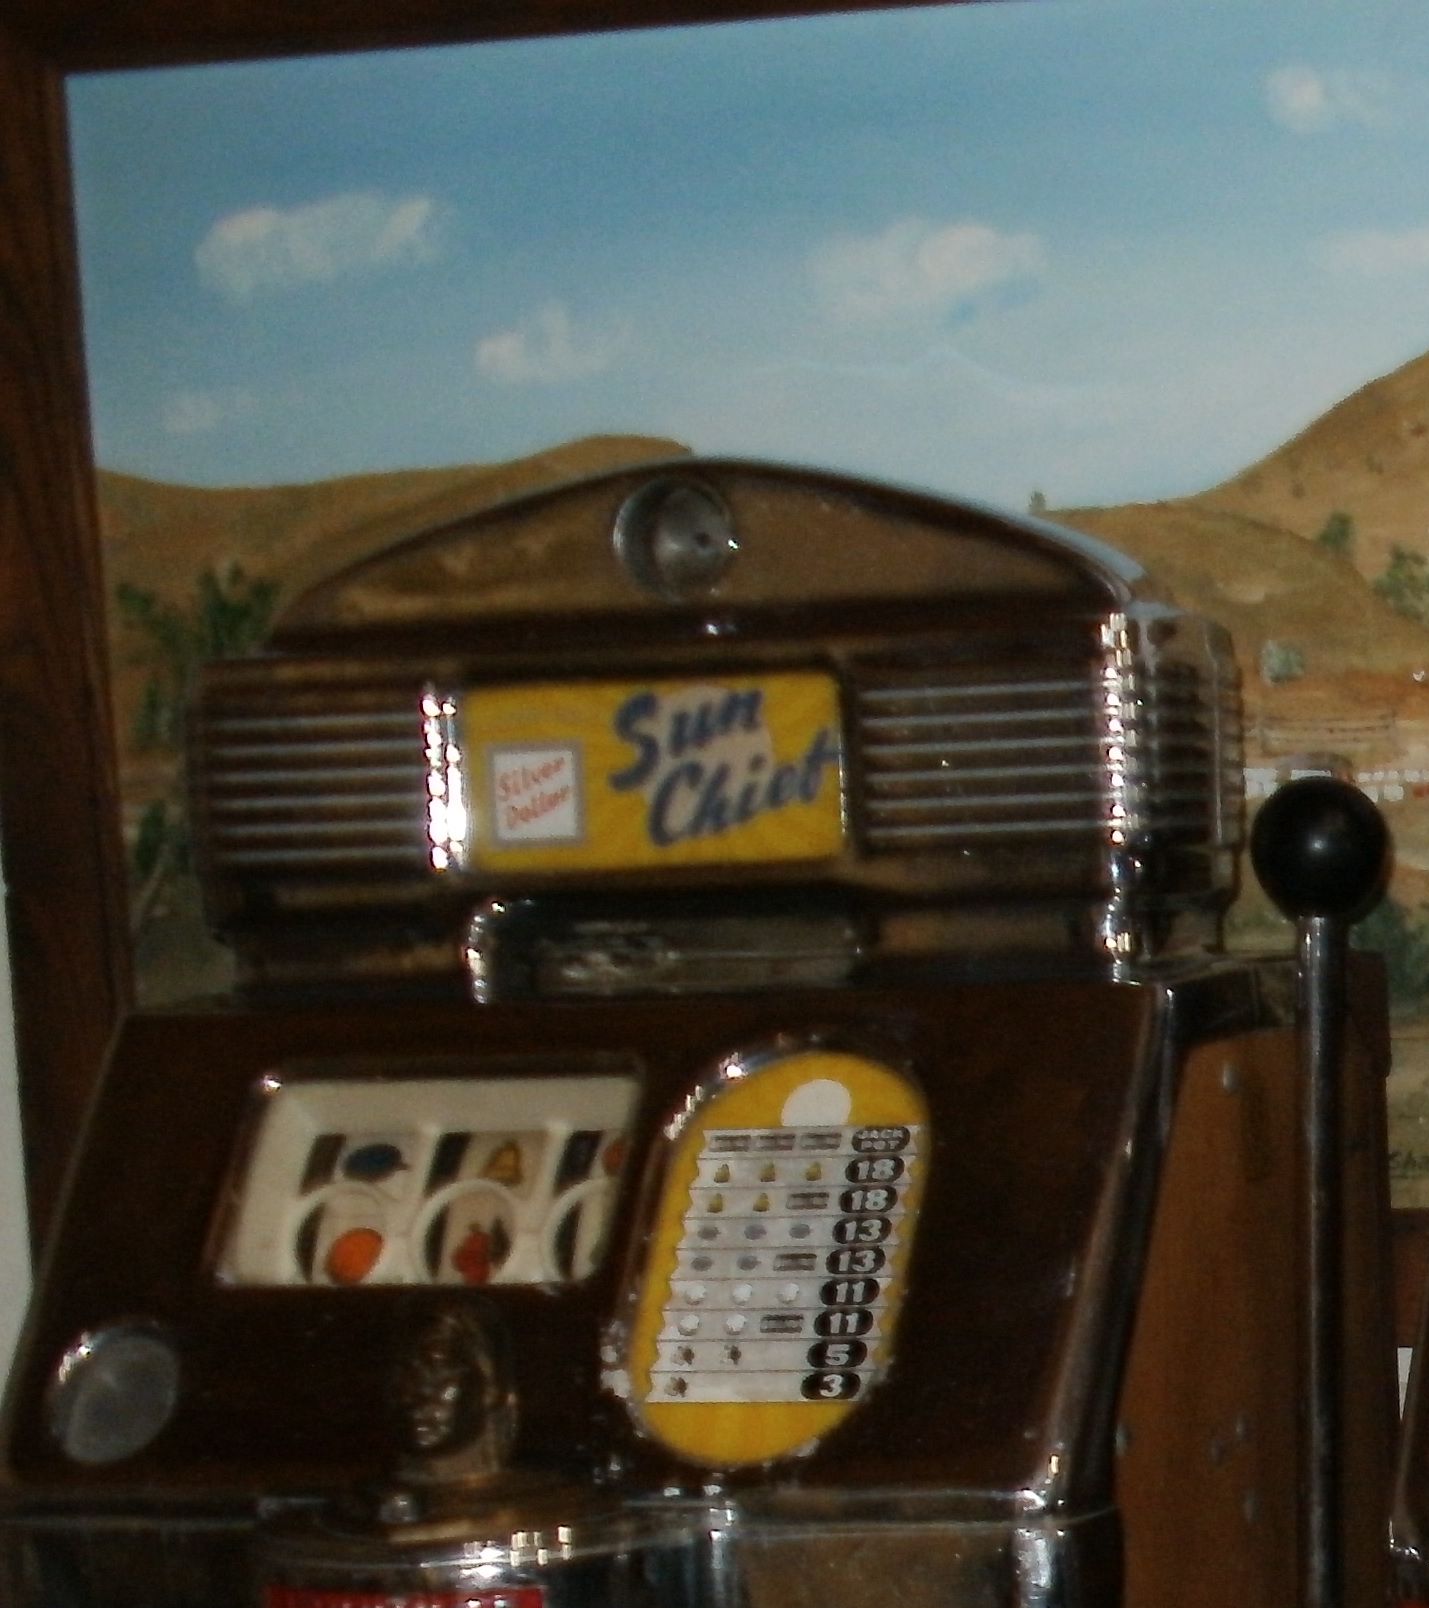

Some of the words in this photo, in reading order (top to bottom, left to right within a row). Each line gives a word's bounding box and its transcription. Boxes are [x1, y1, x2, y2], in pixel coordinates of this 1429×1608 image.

[609, 689, 763, 792] Sun
[648, 728, 841, 848] Chief
[856, 1159, 896, 1179] 18
[850, 1190, 888, 1210] 18
[844, 1219, 882, 1240] 13
[838, 1249, 875, 1271] 13
[836, 1281, 864, 1302] 11
[829, 1312, 858, 1333] 11
[824, 1343, 849, 1365] 5
[820, 1374, 843, 1396] 3
